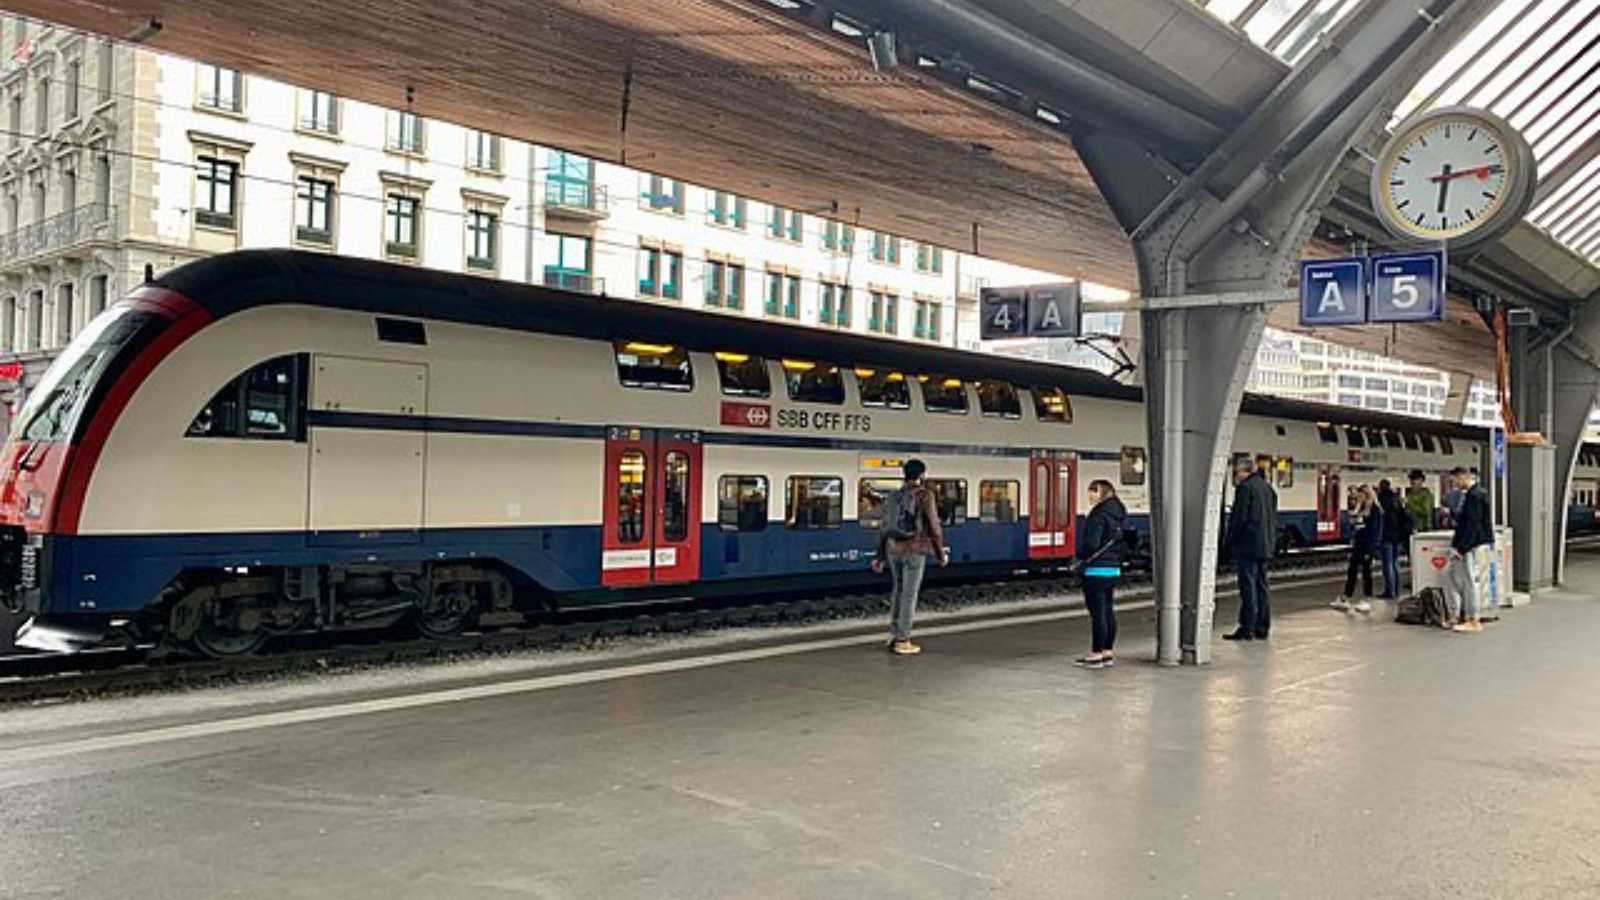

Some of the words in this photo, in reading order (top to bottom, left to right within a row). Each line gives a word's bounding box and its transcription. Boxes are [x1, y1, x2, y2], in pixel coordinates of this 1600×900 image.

[1317, 281, 1346, 313] A
[1391, 274, 1418, 309] 5
[993, 303, 1011, 331] 4
[1041, 300, 1062, 328] A
[777, 409, 809, 428] SBB
[812, 411, 841, 430] CFF
[844, 414, 871, 432] FFS
